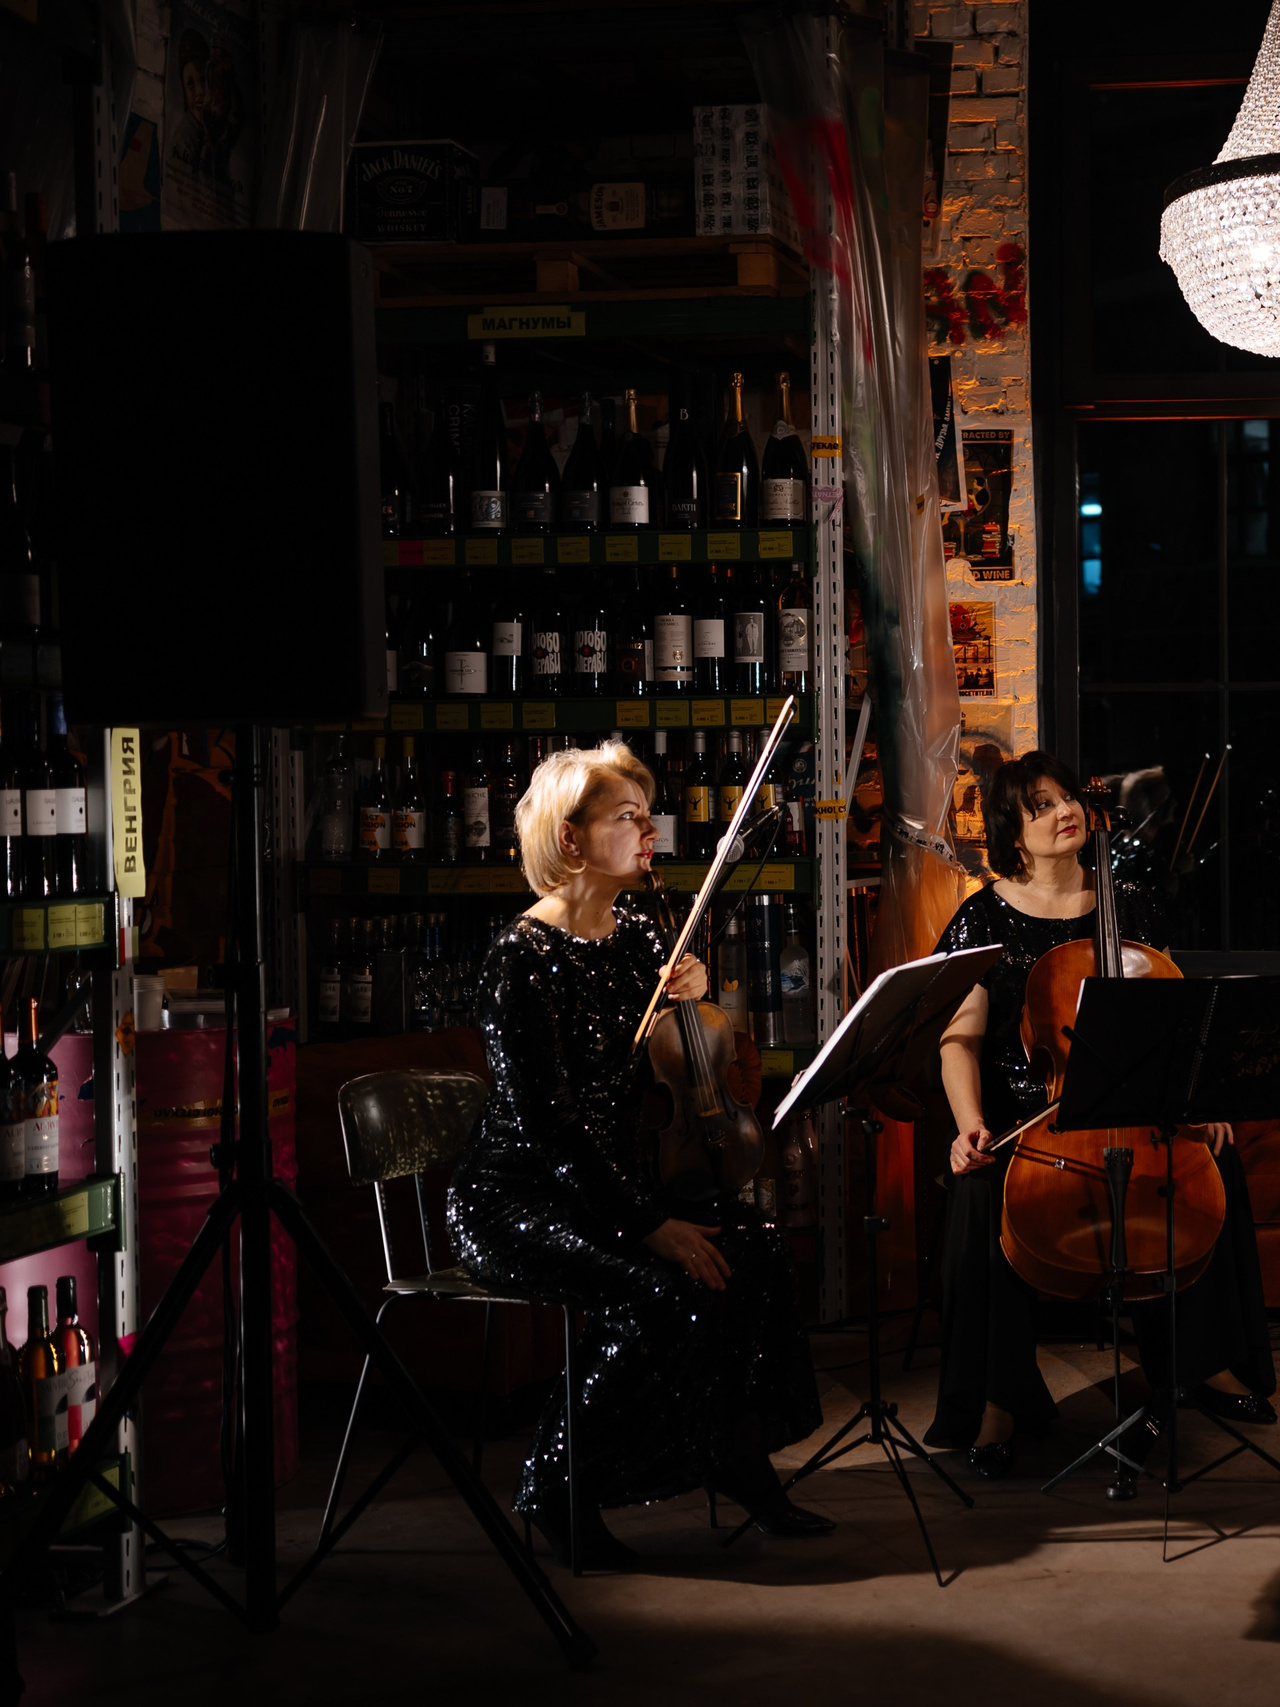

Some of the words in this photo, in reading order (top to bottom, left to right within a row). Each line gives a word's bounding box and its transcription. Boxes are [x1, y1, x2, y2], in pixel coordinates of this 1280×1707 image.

[361, 155, 391, 182] JACK
[593, 186, 607, 229] JAMESON
[481, 315, 572, 332] МАГНУМЫ
[982, 569, 1010, 580] WINE
[121, 736, 138, 873] ВЕНГРИЯ
